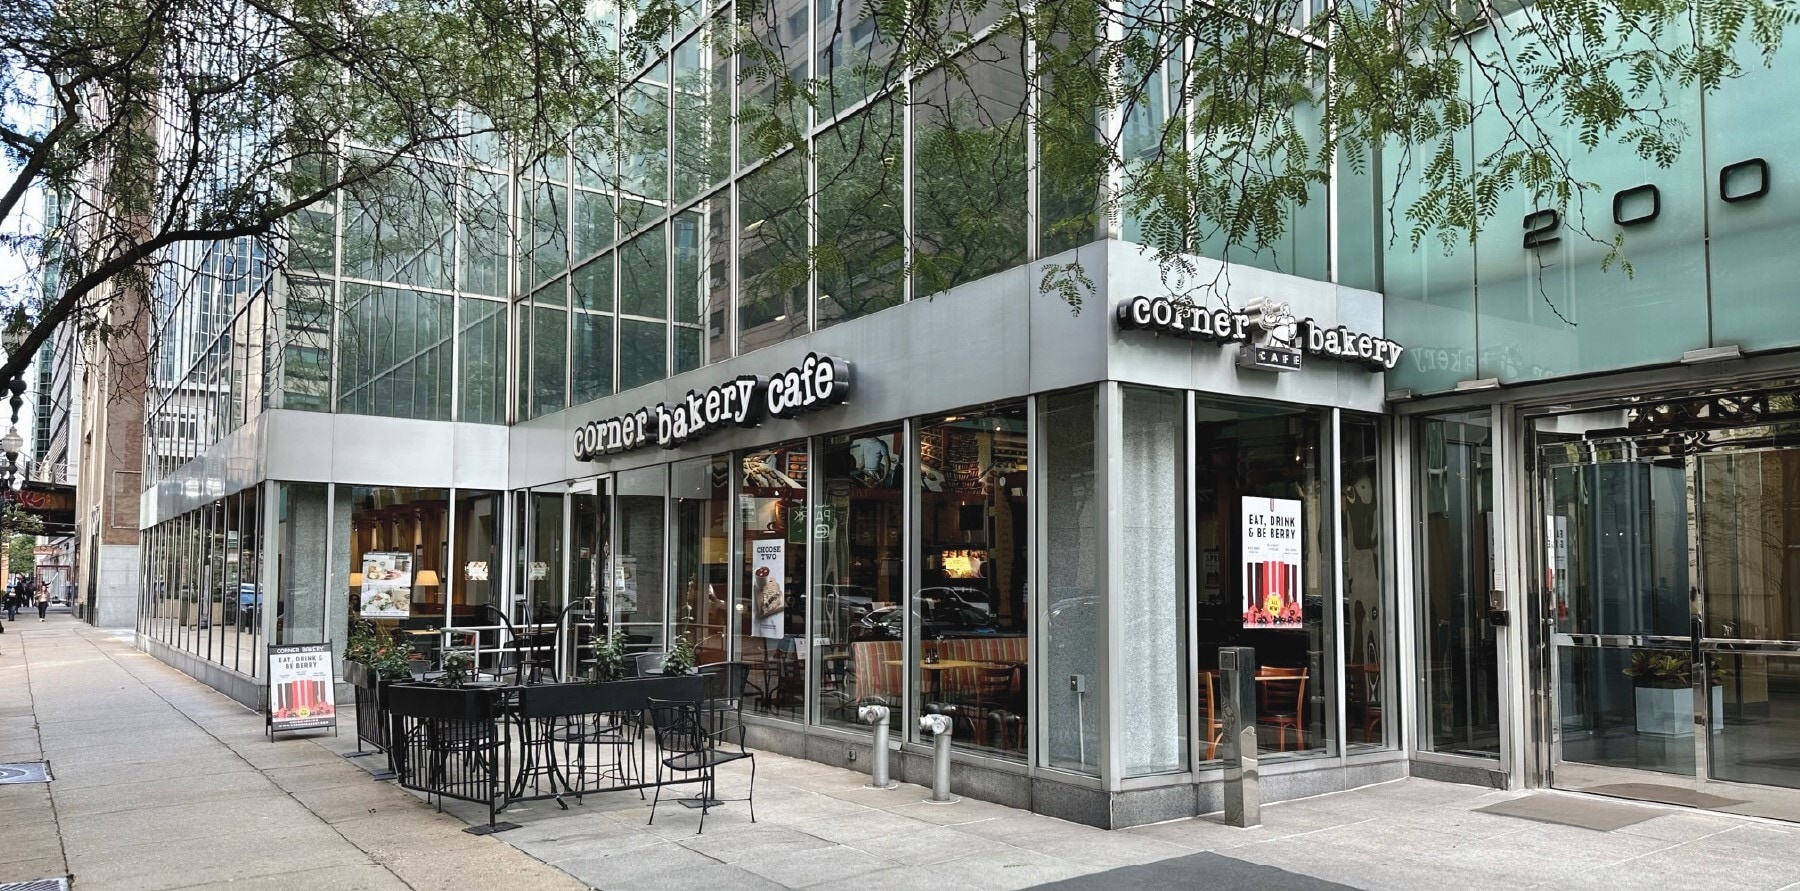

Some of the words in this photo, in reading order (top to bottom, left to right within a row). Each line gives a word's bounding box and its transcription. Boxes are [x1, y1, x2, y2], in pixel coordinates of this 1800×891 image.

[1132, 297, 1250, 339] corner
[1305, 318, 1404, 369] bakery
[1257, 350, 1301, 365] CAFE
[573, 409, 649, 458] corner
[655, 378, 756, 445] bakery
[767, 354, 834, 415] cafe
[1248, 513, 1267, 527] EAT,
[1270, 515, 1295, 527] DRINK
[1248, 527, 1254, 538] &
[1257, 527, 1267, 538] BE
[1270, 527, 1296, 540] BERRY
[756, 545, 782, 553] CHOOSE
[295, 661, 317, 669] BERRY
